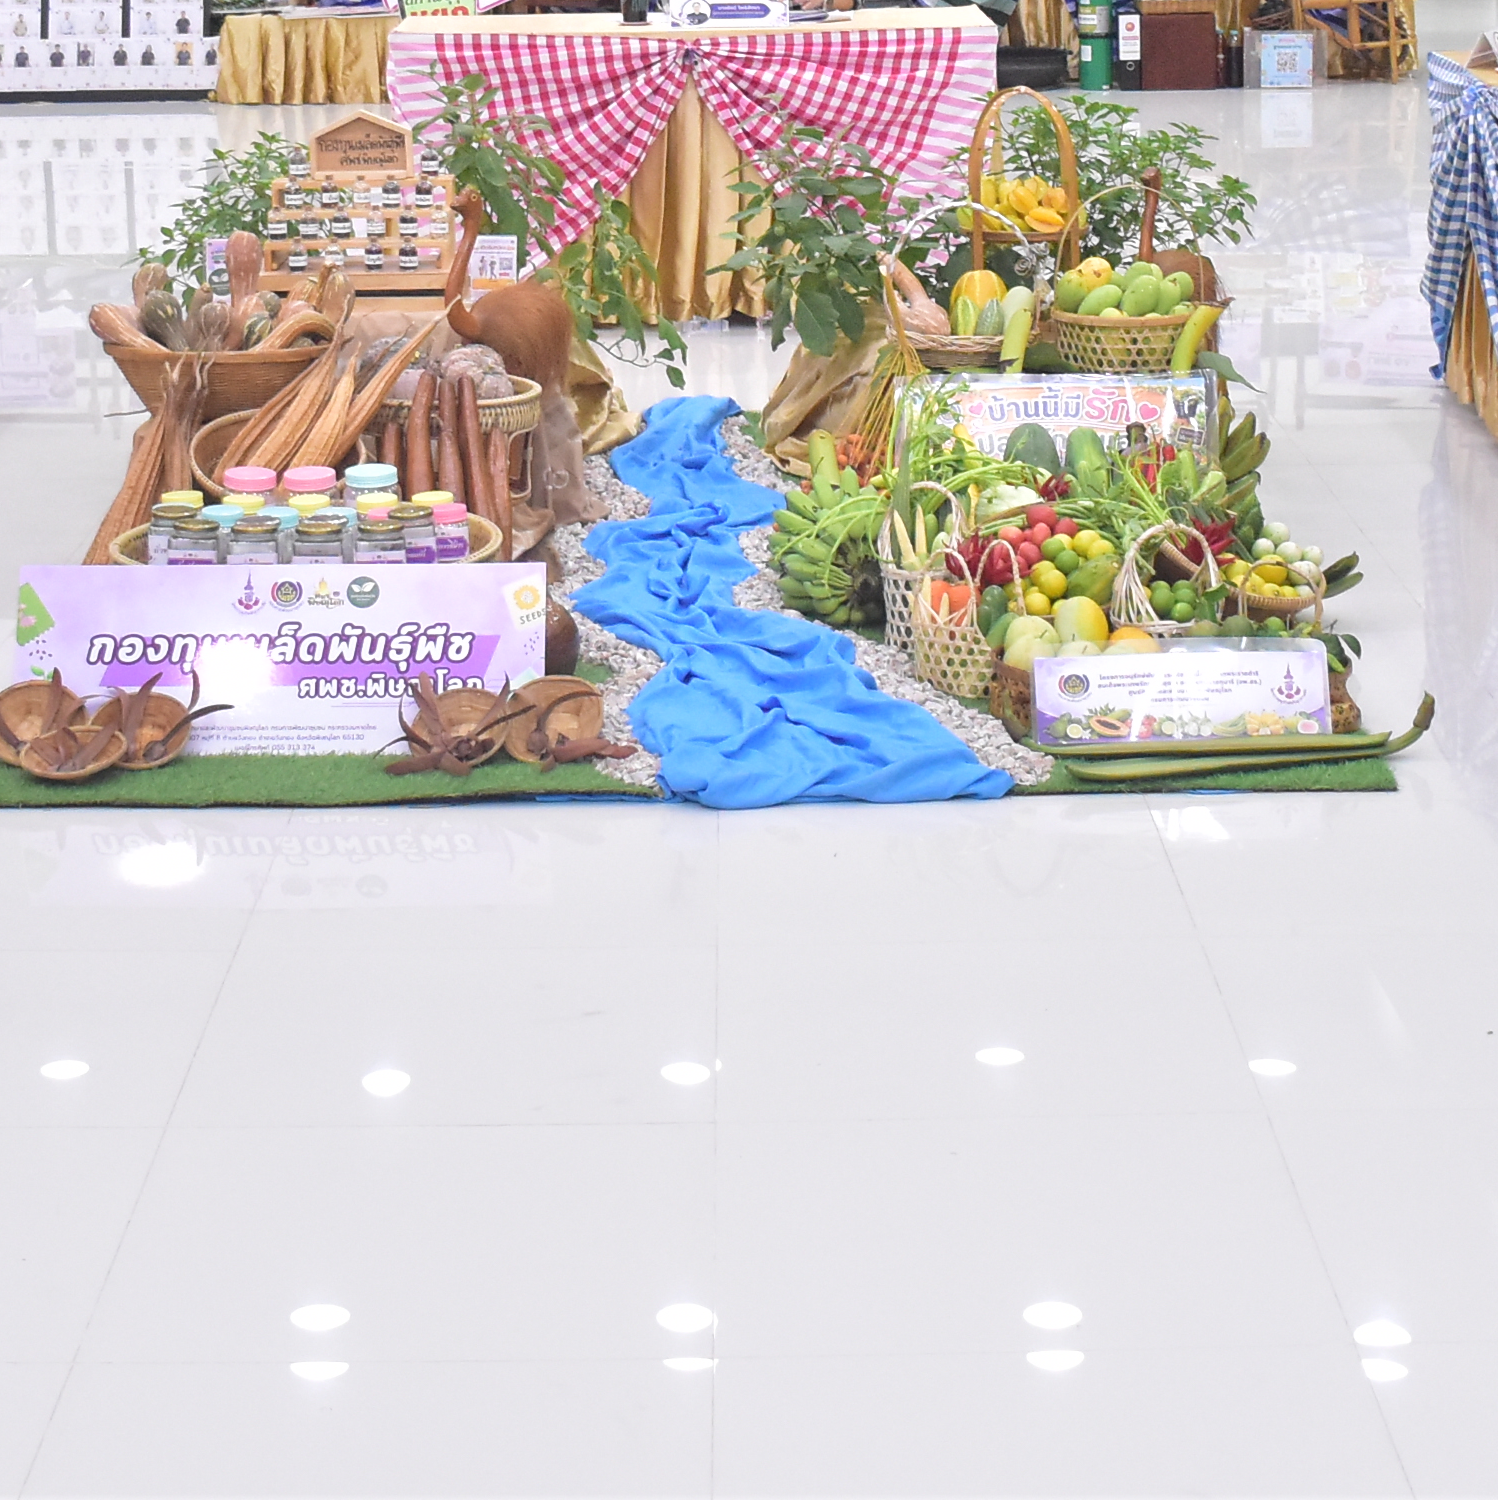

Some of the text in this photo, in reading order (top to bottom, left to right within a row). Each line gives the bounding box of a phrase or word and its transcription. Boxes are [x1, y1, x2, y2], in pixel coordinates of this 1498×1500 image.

[86, 621, 475, 677] กองทุล็ดพันธุ์พืช
